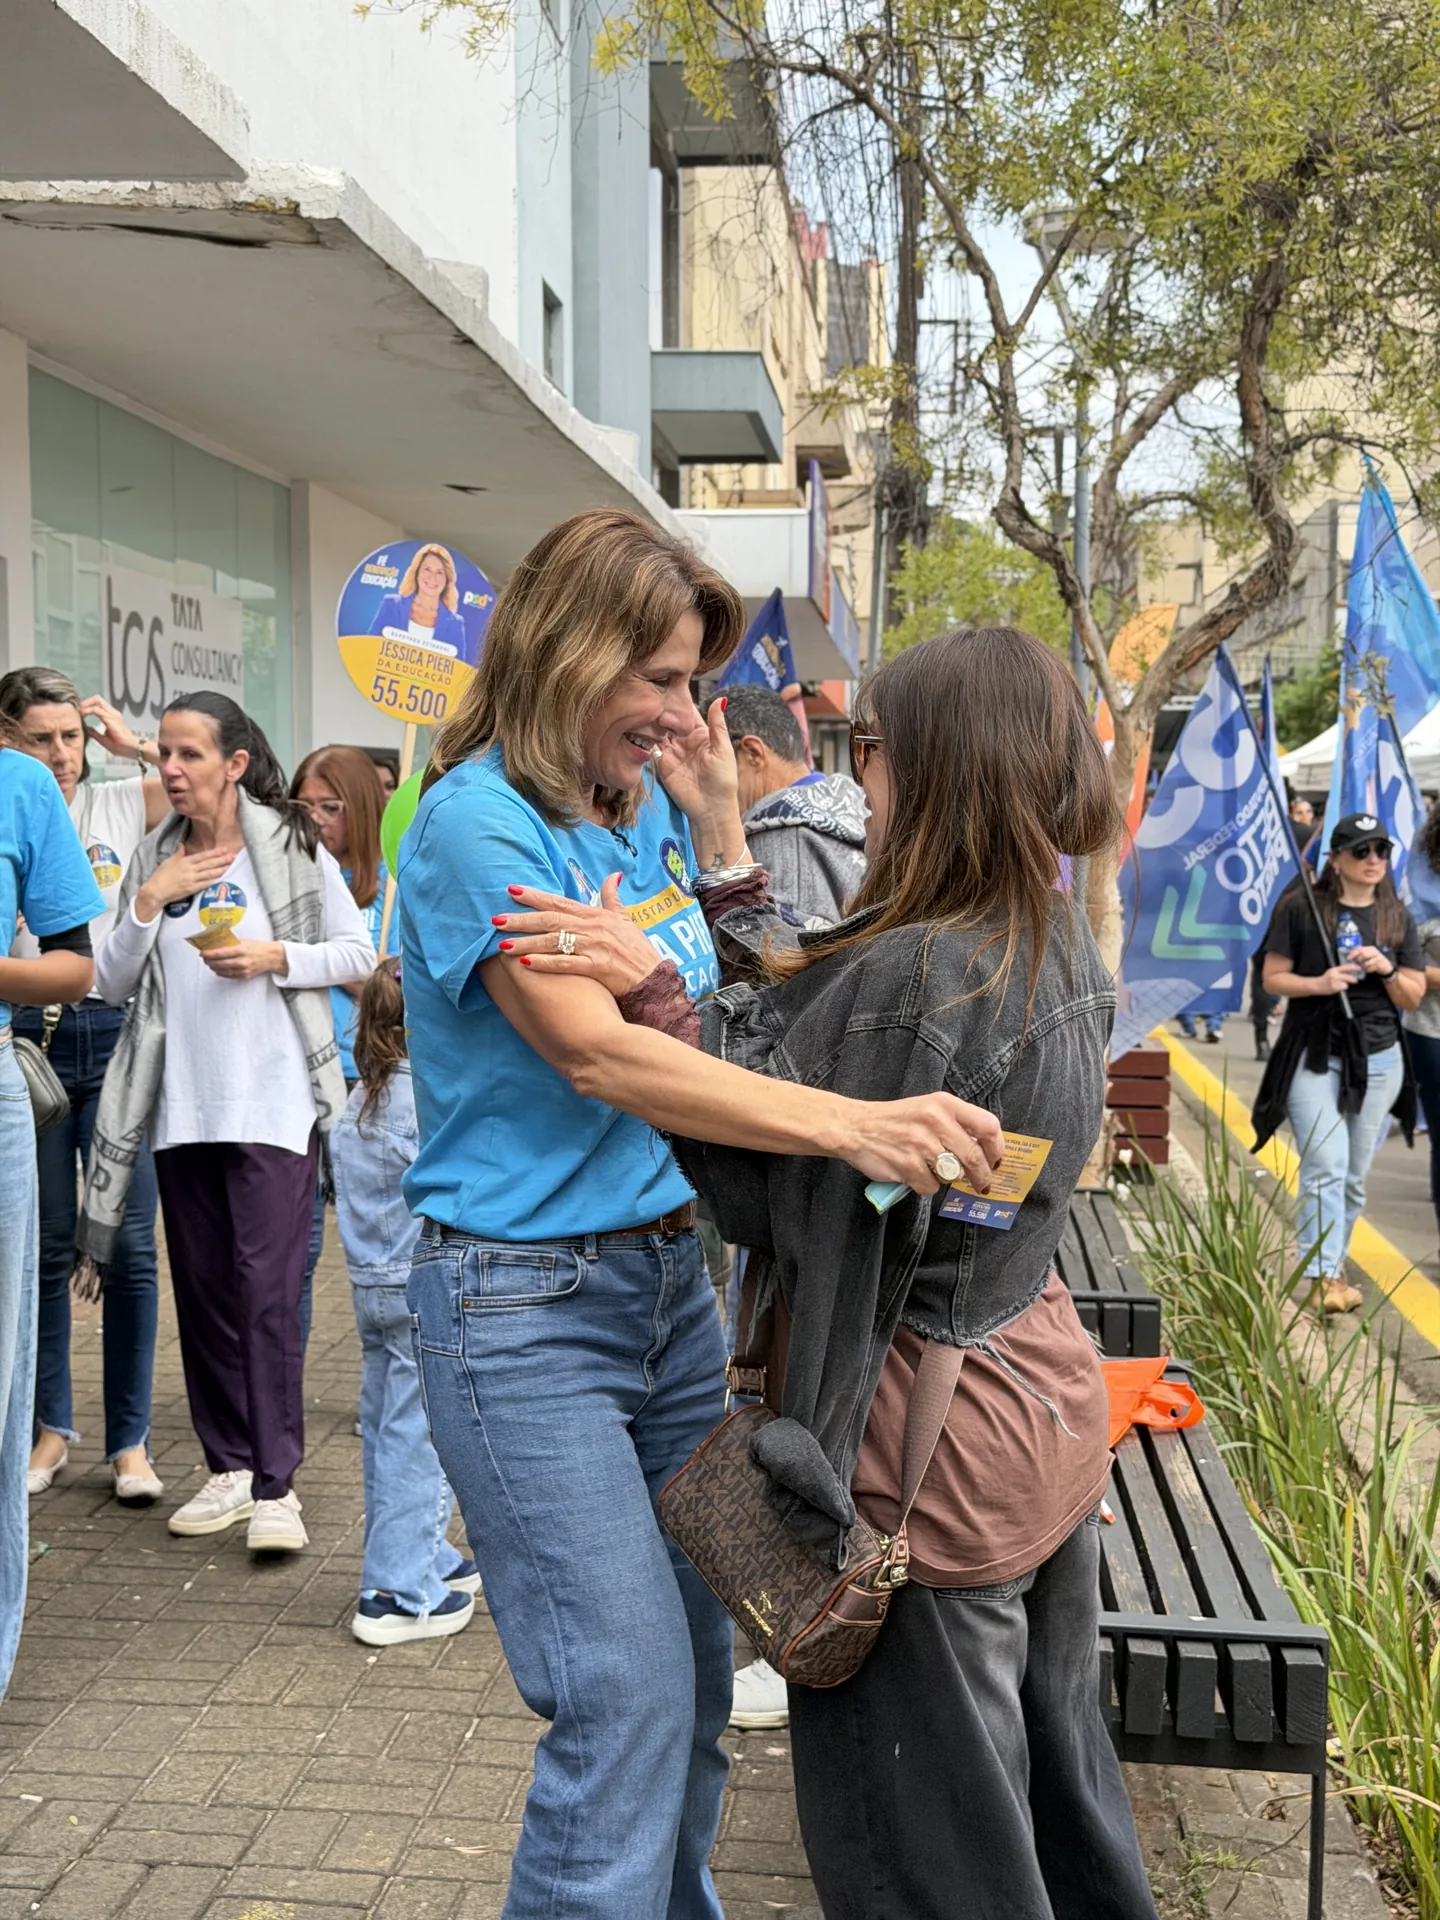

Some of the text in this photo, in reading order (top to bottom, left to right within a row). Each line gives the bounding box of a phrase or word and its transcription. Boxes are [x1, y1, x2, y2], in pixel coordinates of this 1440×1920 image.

[171, 592, 204, 632] TATA
[171, 641, 243, 686] CONSULTANCY
[377, 658, 452, 686] DA EDUCAÇÃO
[379, 641, 456, 675] JESSICA PIERI
[371, 675, 448, 719] 55.500
